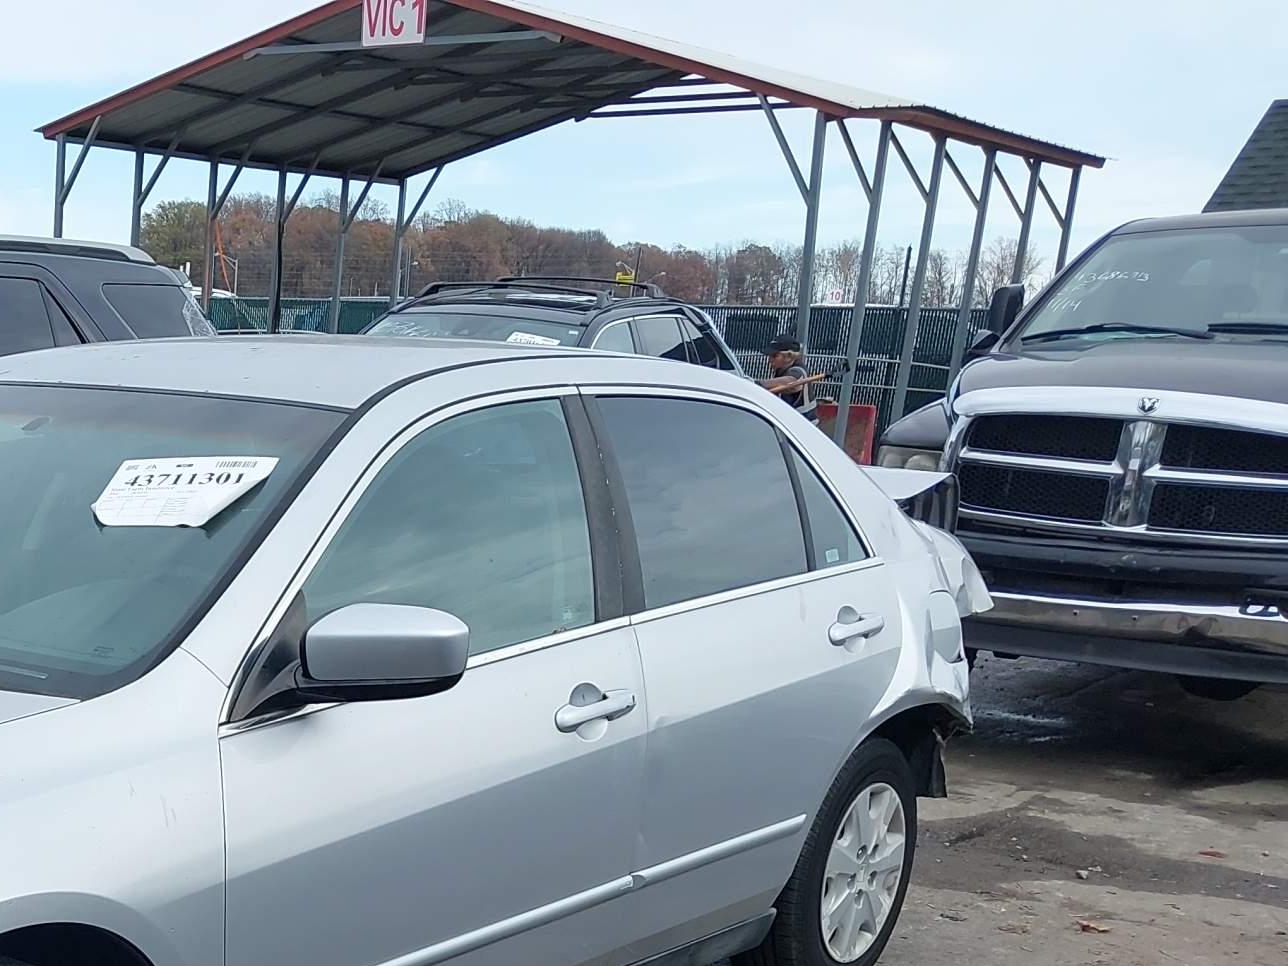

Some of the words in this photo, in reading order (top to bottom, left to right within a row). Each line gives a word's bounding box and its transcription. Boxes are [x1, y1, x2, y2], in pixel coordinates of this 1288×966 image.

[365, 0, 405, 37] VIC
[412, 0, 424, 34] 1
[124, 472, 245, 487] 43711301
